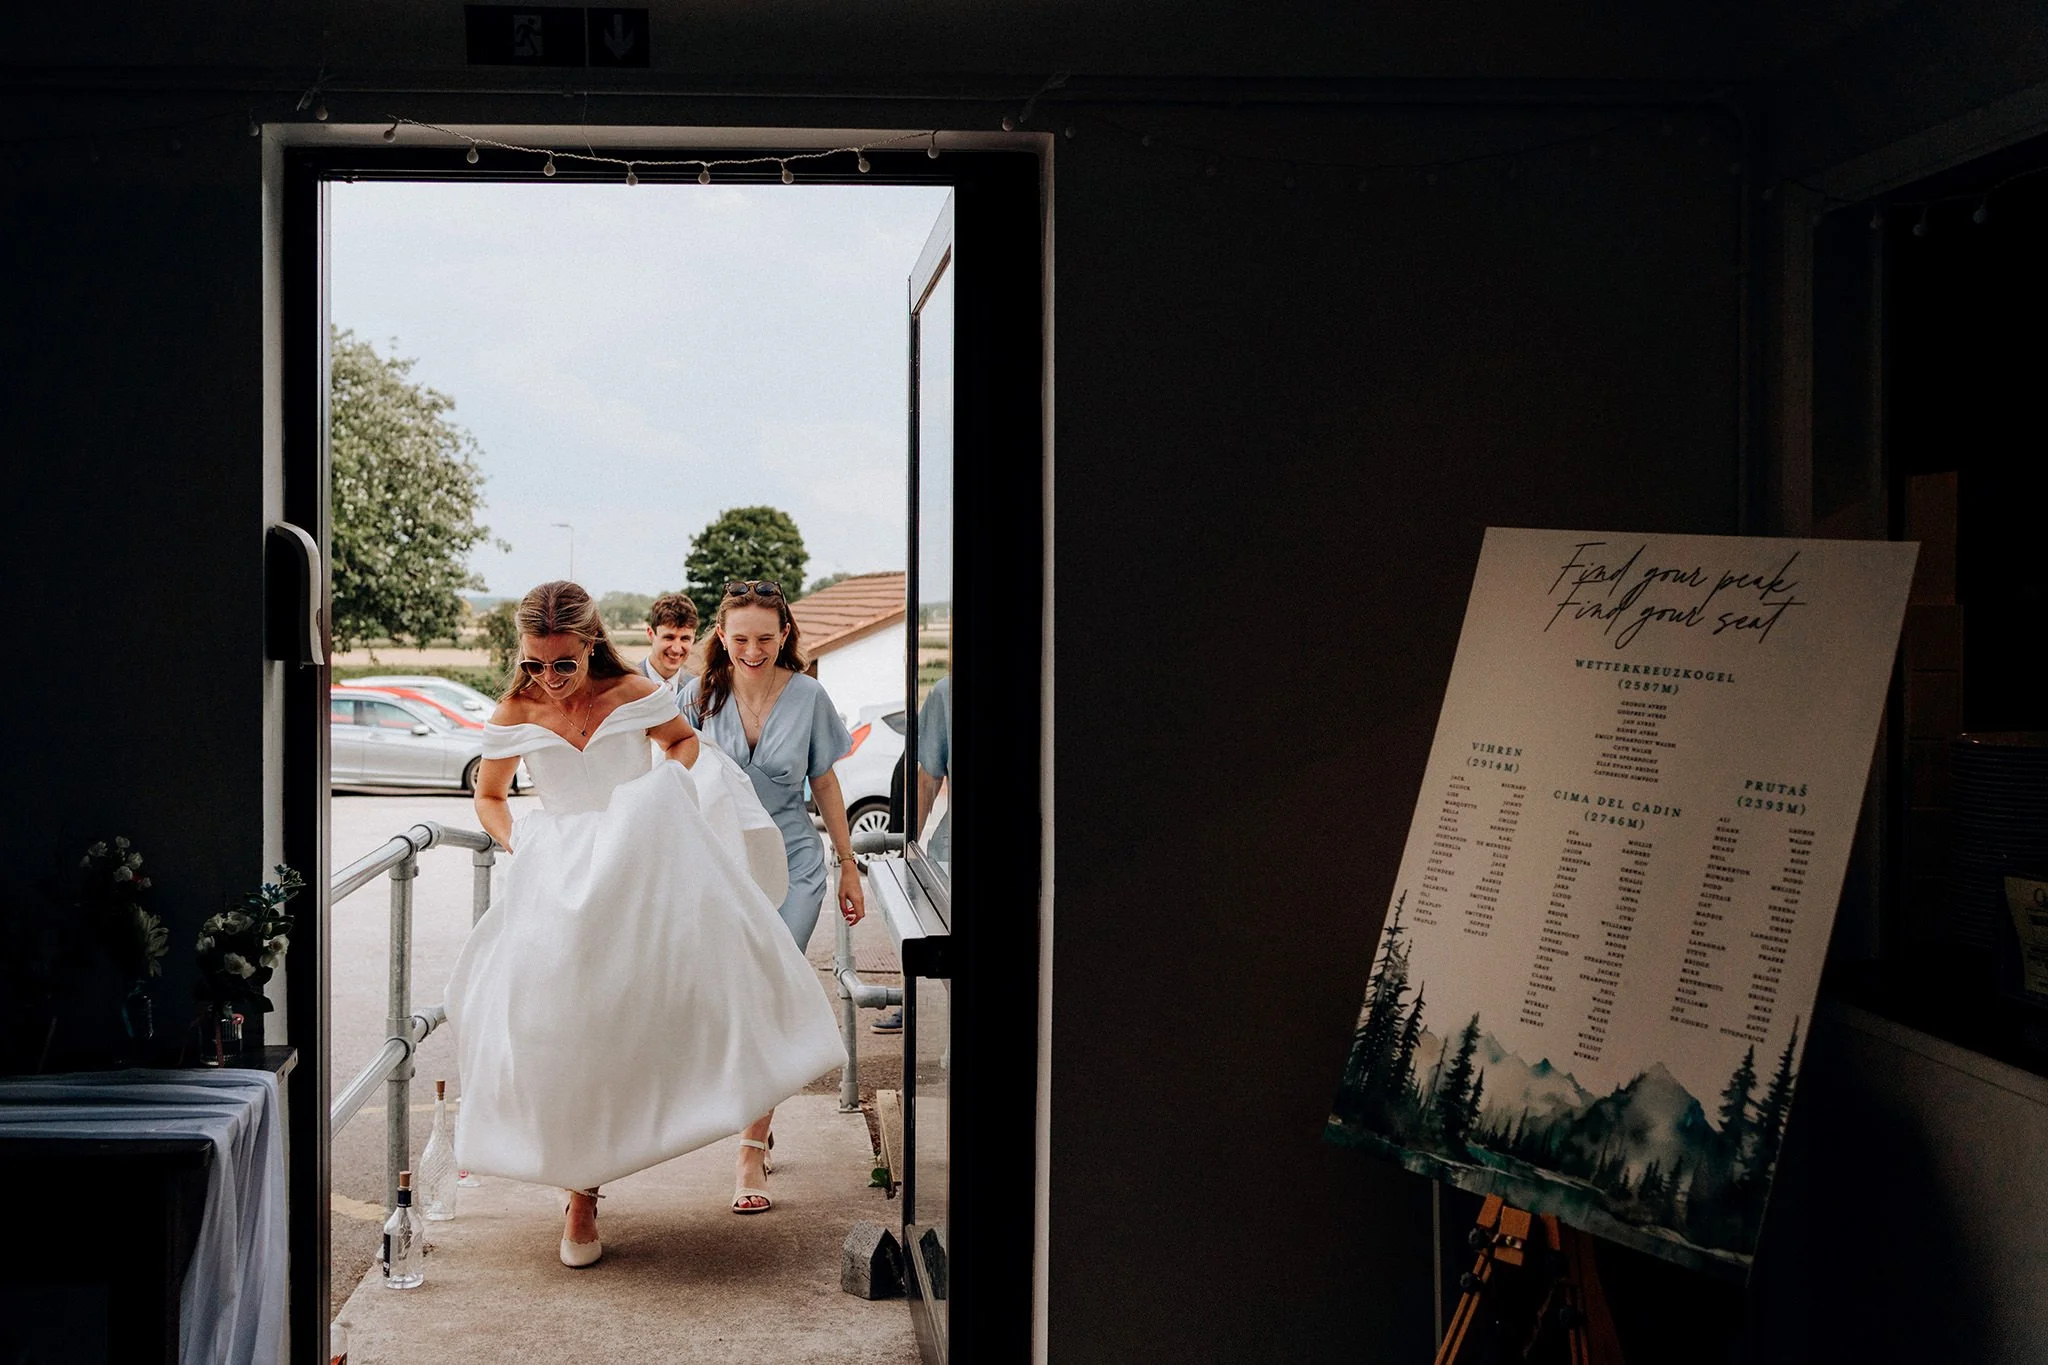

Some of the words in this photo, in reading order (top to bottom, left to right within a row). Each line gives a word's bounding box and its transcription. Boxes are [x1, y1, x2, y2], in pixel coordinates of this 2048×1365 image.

[1548, 542, 1647, 598] Find
[1618, 566, 1707, 611] your
[1699, 551, 1800, 613] peak
[1544, 580, 1644, 636] Find
[1615, 605, 1705, 650] your
[1713, 596, 1807, 644] seat
[1575, 659, 1735, 683] WETTERKREUZKOGEL
[1617, 678, 1679, 695] (2587M)
[1472, 742, 1522, 756] VIHREN
[1467, 757, 1519, 773] (2914M)
[1744, 779, 1807, 797] PRUTAŠ
[1553, 790, 1589, 803] CIMA
[1597, 796, 1624, 809] DEL
[1632, 801, 1681, 817] CADIN
[1737, 795, 1806, 816] (2393M)
[1584, 810, 1645, 830] (2746M)
